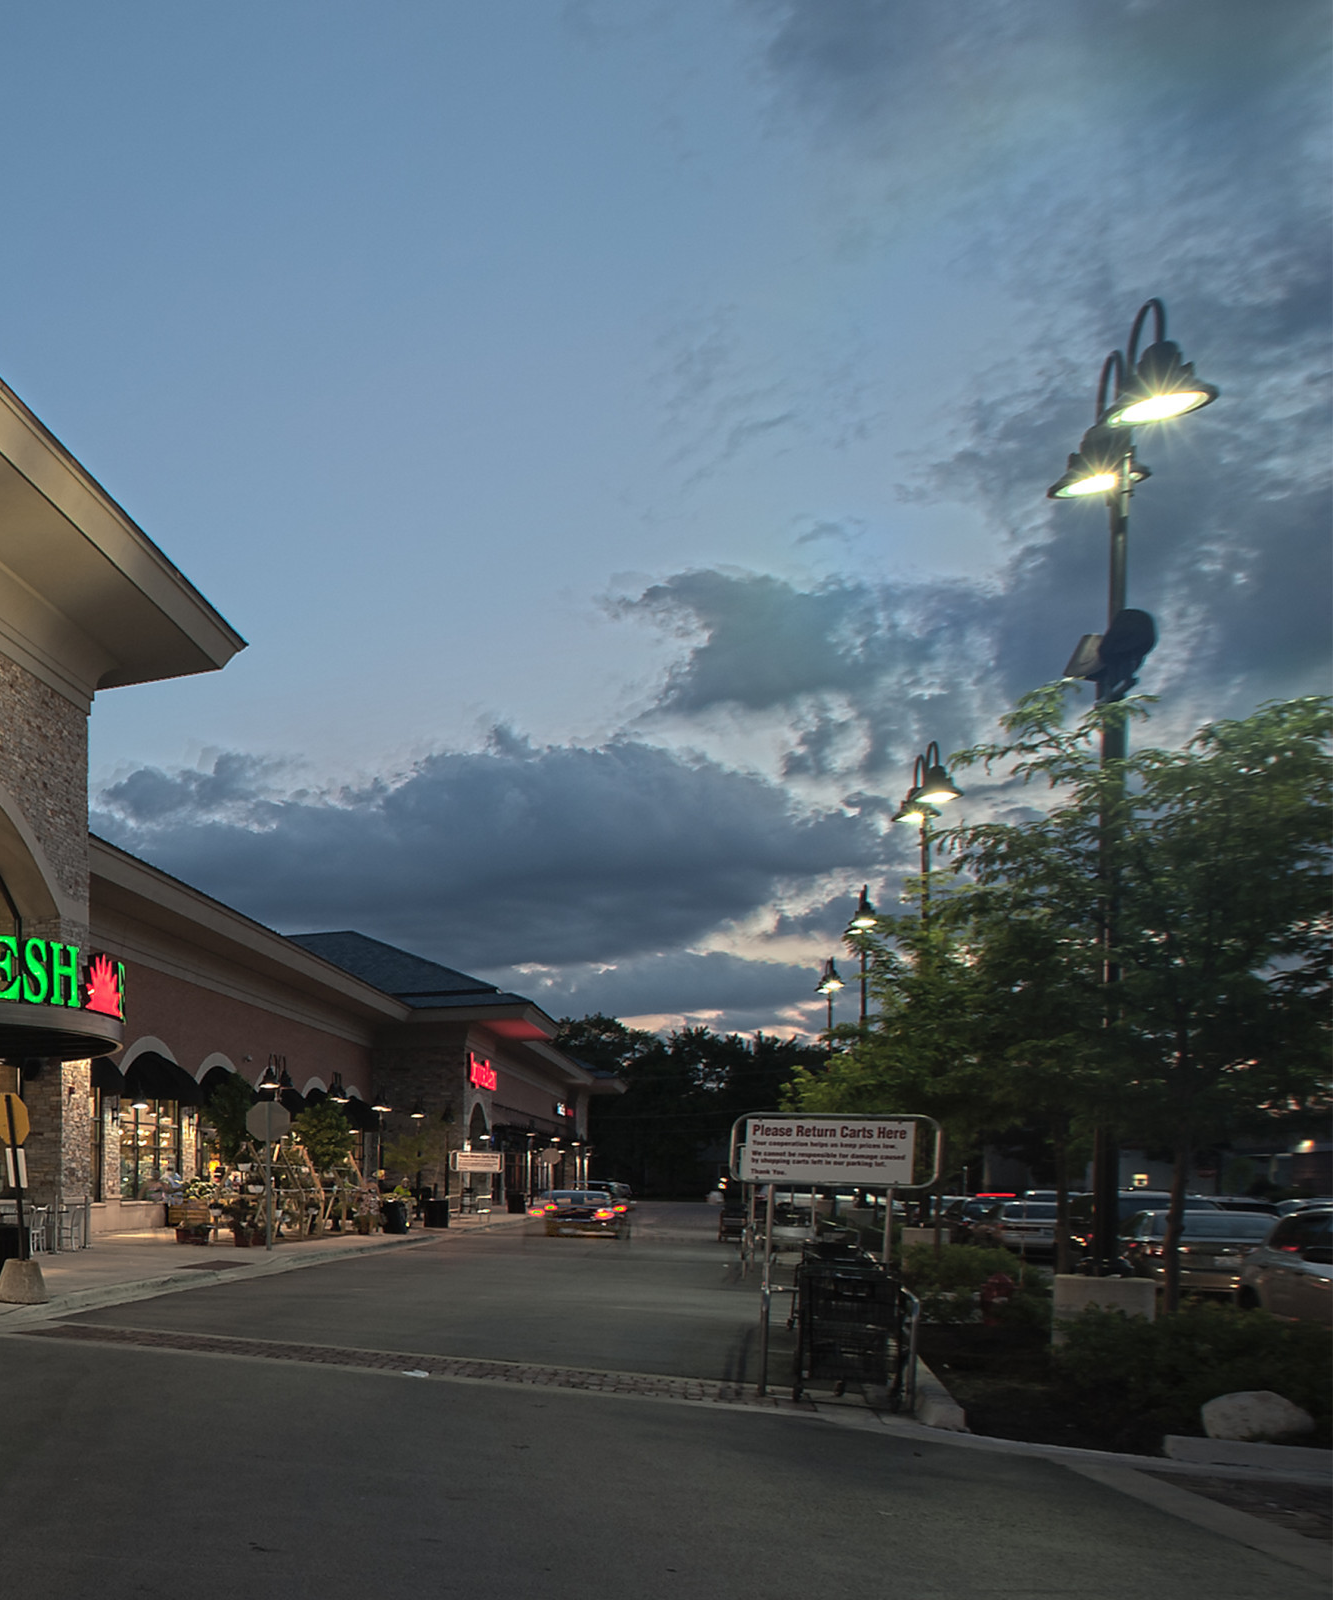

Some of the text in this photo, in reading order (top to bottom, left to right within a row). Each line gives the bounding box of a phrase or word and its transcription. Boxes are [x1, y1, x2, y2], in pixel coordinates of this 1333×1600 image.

[752, 1124, 907, 1139] Please Return Carts Here
[850, 1153, 879, 1161] damage
[846, 1160, 872, 1168] parking
